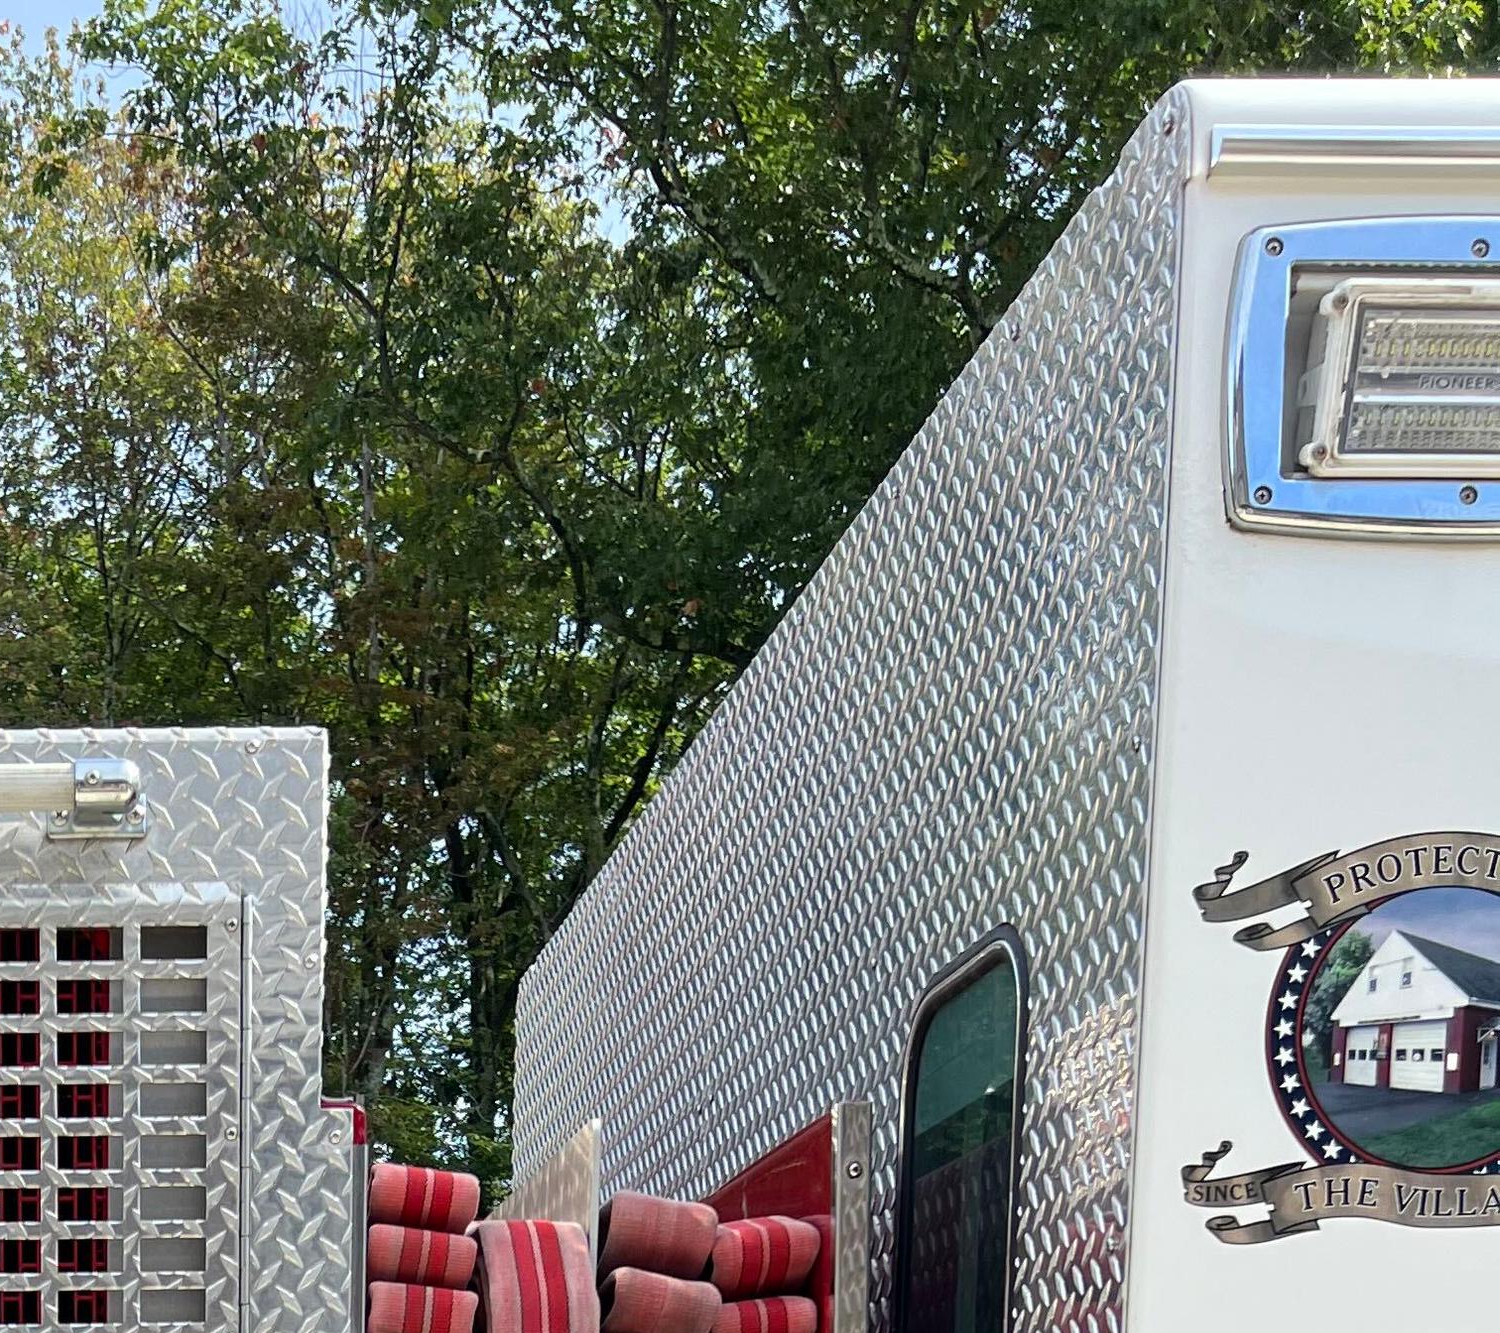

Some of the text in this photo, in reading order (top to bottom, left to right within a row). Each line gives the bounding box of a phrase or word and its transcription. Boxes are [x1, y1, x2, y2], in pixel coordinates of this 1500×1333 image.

[1419, 374, 1494, 390] PIONEER
[1322, 845, 1500, 904] PROTECT
[1193, 1182, 1257, 1201] SINCE
[1295, 1178, 1500, 1217] THE VILLA
